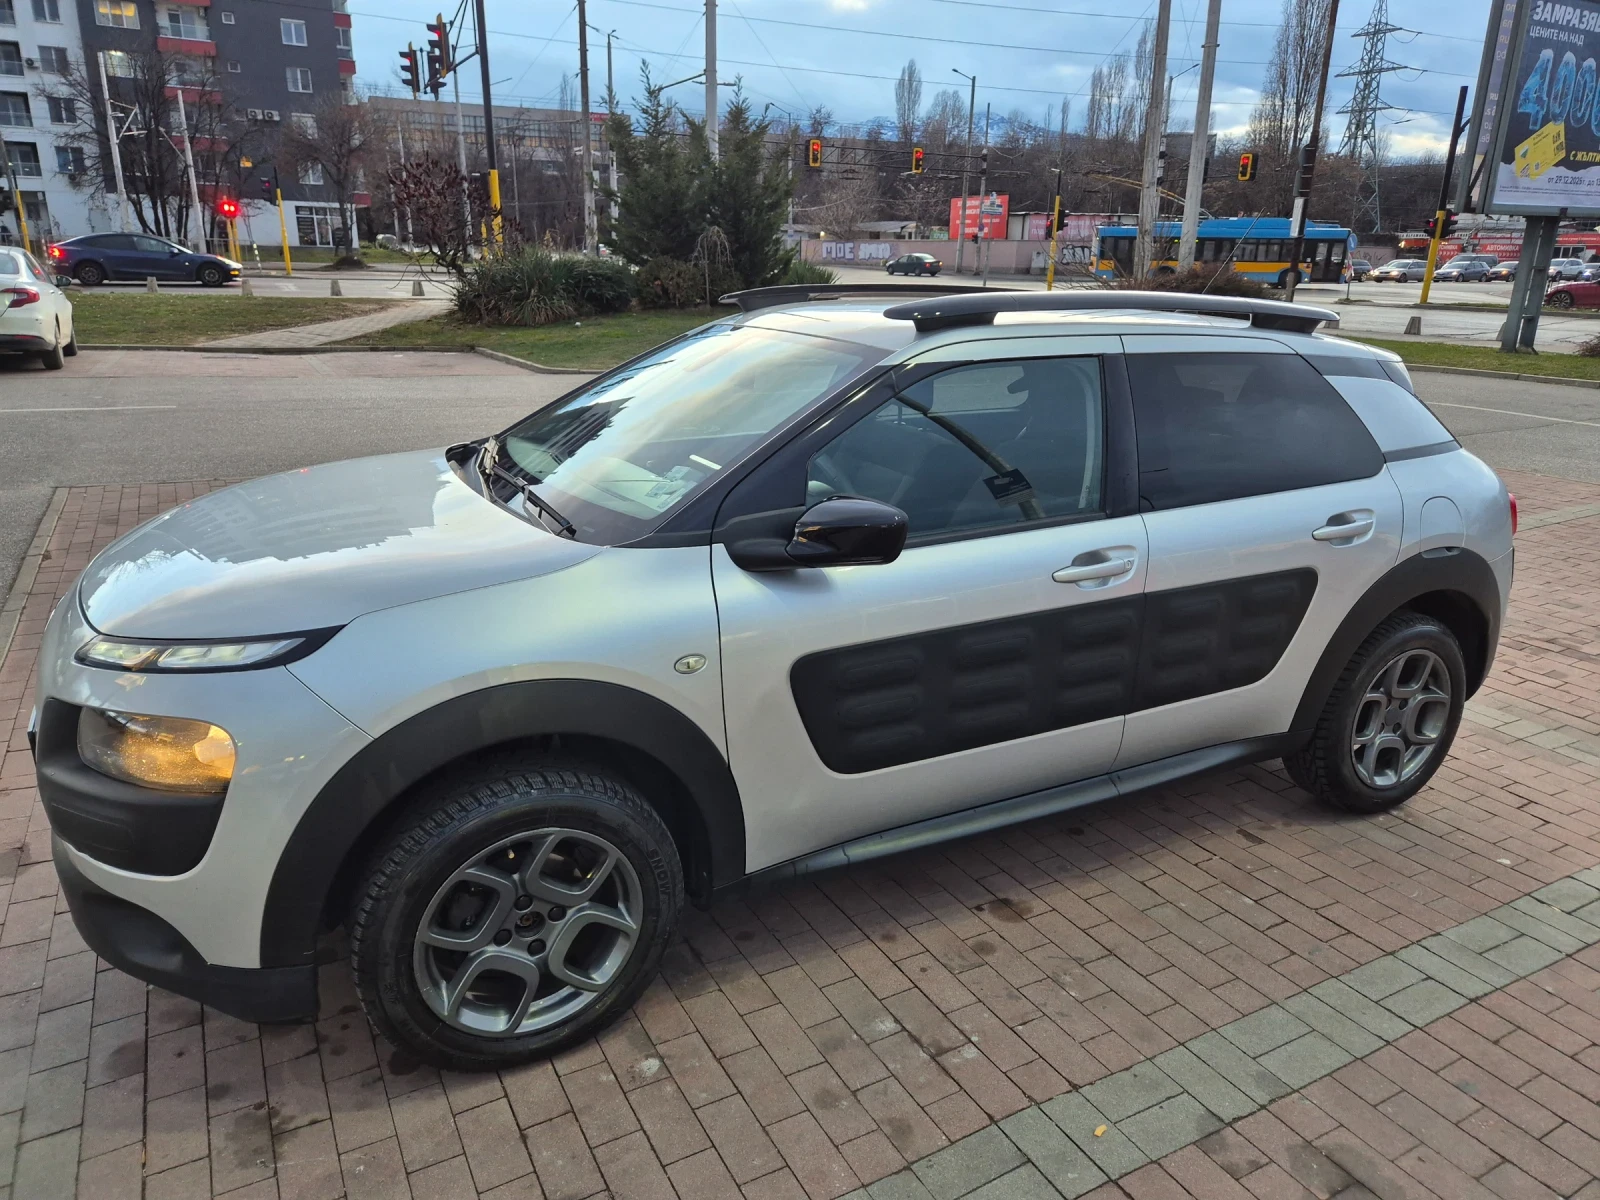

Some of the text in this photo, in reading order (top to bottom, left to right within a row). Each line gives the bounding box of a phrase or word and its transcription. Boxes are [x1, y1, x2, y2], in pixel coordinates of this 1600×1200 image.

[1530, 25, 1584, 47] ЦЕНИТЕ НА НАД
